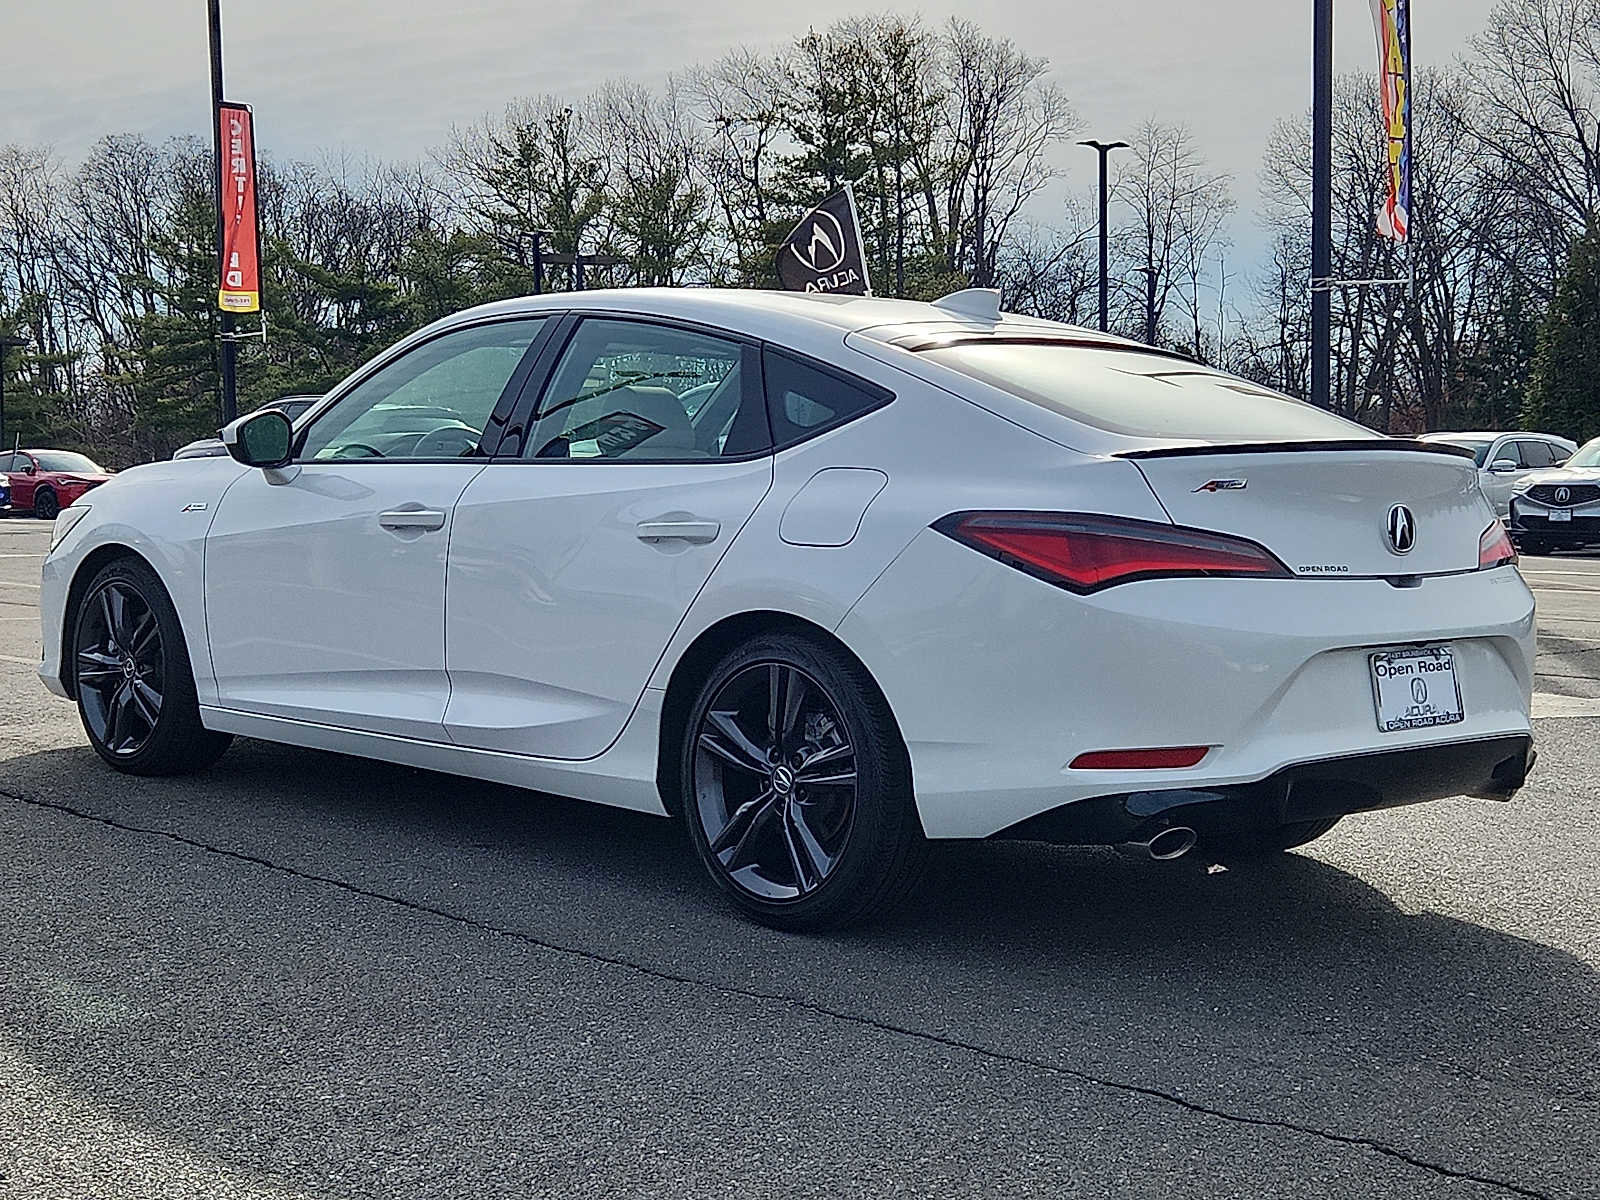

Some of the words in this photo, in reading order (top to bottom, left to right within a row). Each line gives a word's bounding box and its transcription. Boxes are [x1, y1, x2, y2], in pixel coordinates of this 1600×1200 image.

[1376, 664, 1413, 679] Open
[1418, 659, 1451, 673] Road
[1388, 720, 1411, 730] OPEN
[1412, 717, 1434, 726] ROAD
[1436, 714, 1460, 724] ACURA
